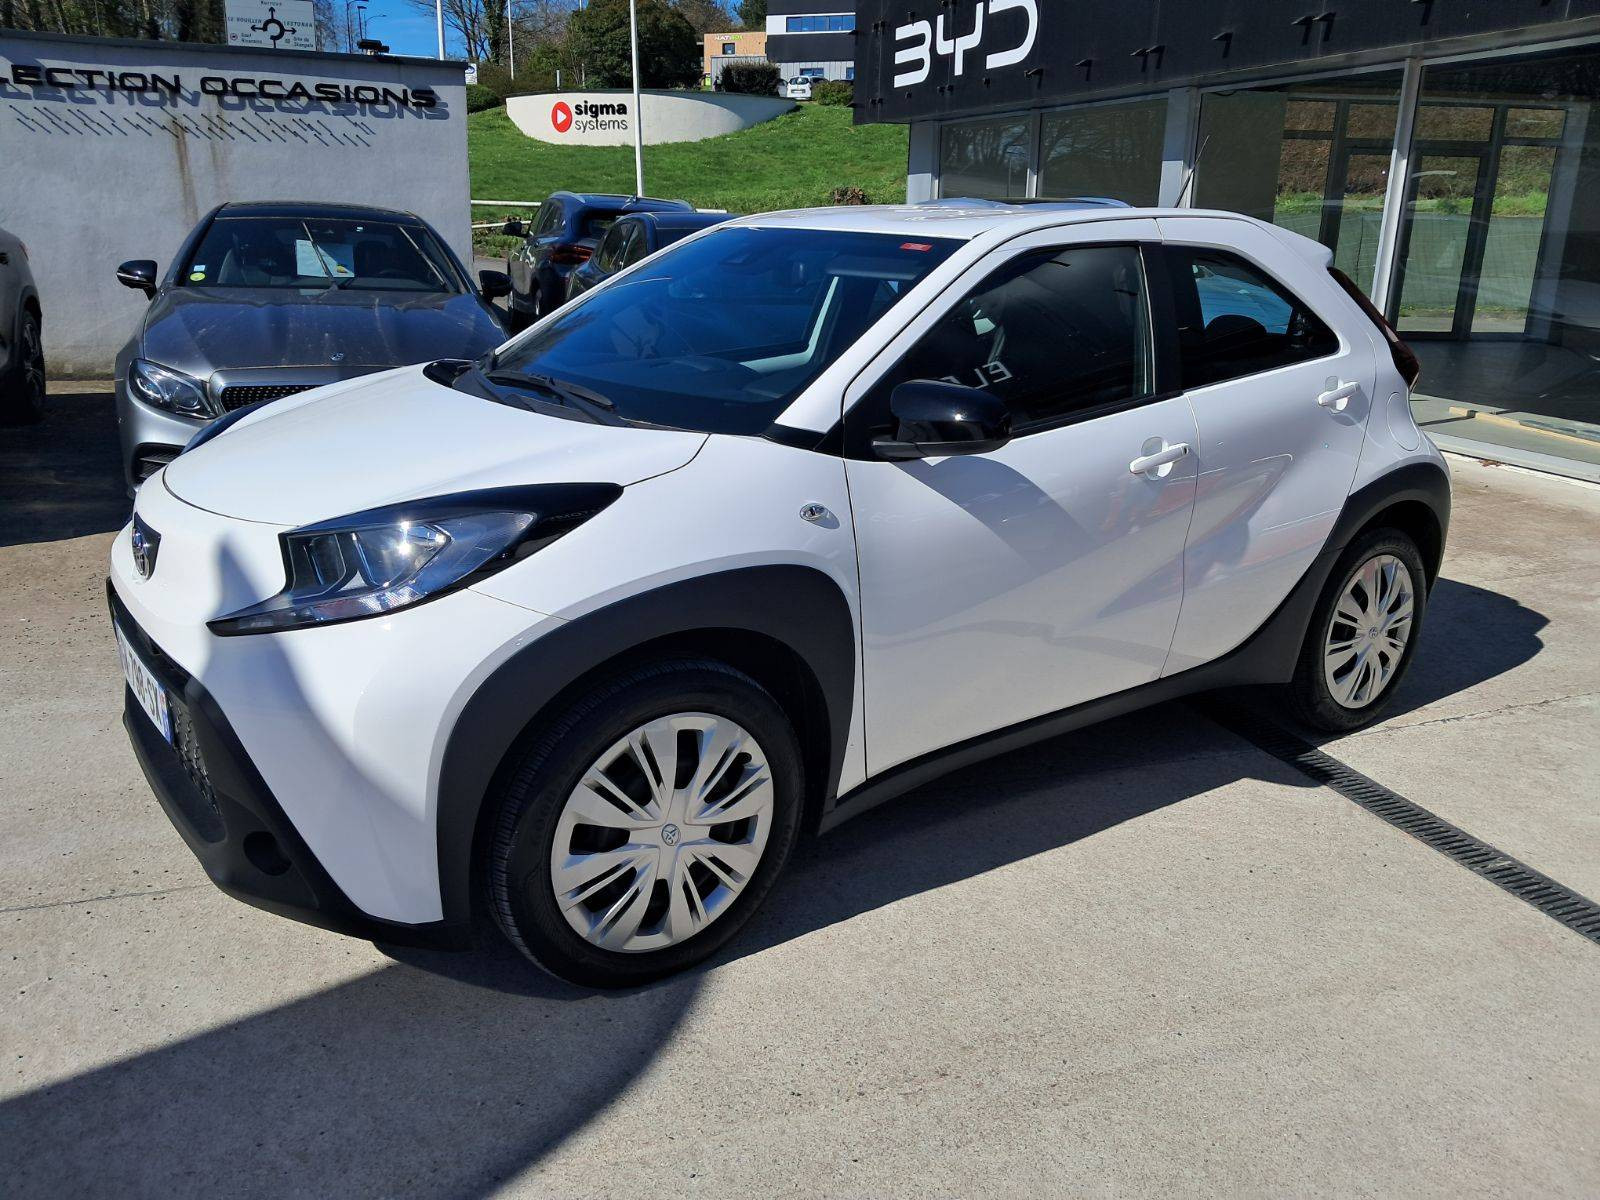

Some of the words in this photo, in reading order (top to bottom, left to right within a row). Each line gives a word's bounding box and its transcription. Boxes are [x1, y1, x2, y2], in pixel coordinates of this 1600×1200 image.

[894, 0, 1038, 89] BYD
[200, 76, 438, 108] OCCASIONS
[575, 100, 628, 118] sigma
[575, 119, 629, 133] systems
